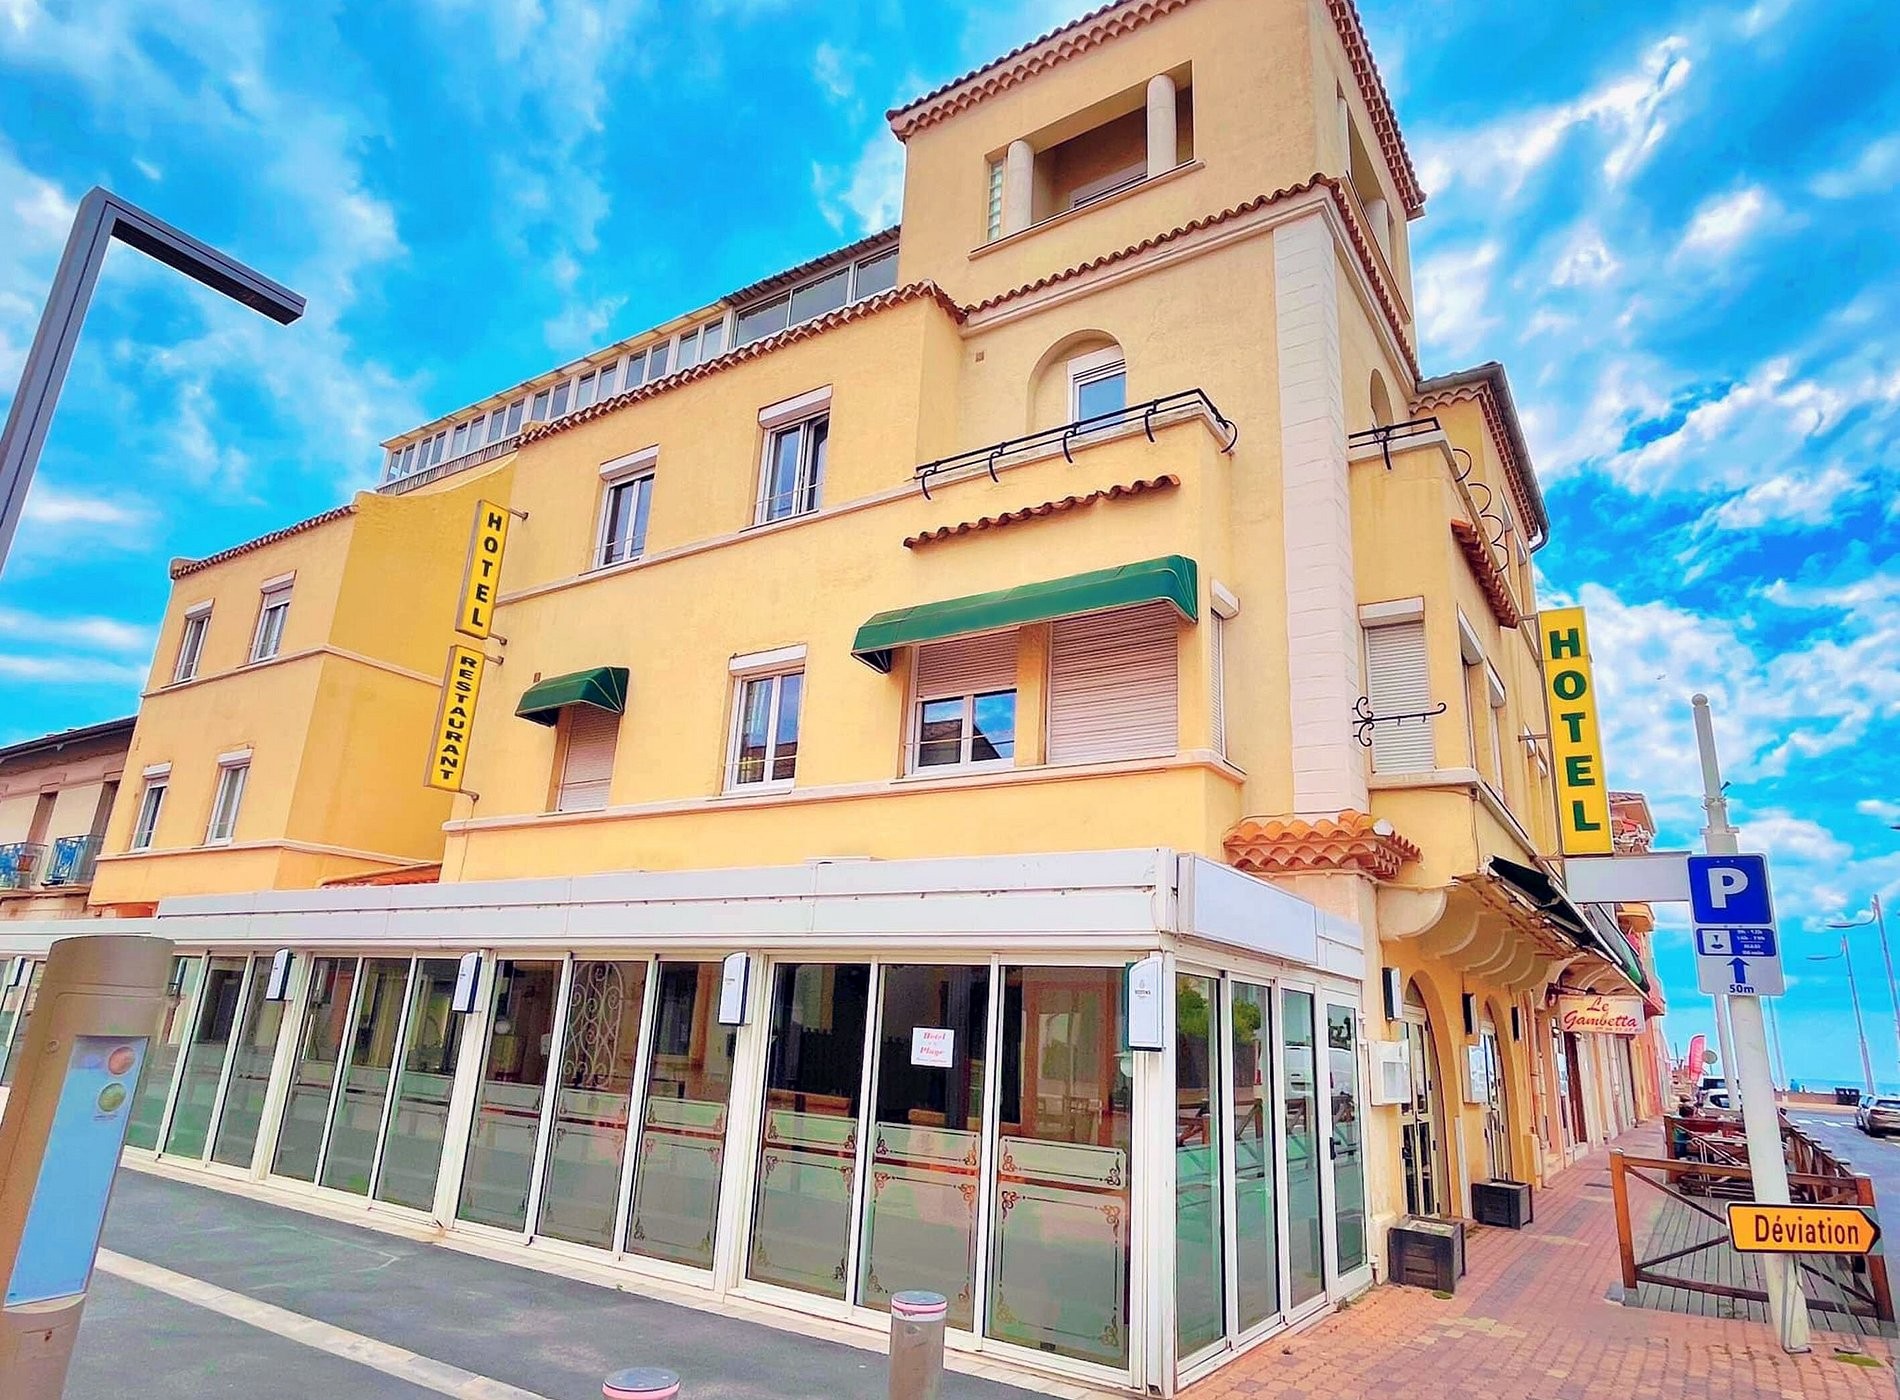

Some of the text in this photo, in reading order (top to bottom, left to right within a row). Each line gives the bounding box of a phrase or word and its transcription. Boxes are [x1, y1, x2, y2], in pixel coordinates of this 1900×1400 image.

[472, 512, 503, 628] HOTEL
[440, 655, 477, 780] RESTAURANT
[1548, 627, 1601, 832] HOTEL
[1707, 867, 1748, 908] P
[1586, 996, 1609, 1012] Le
[1729, 984, 1754, 993] 50m
[1564, 1010, 1637, 1030] Gambetta
[1755, 1214, 1859, 1245] Déviation
